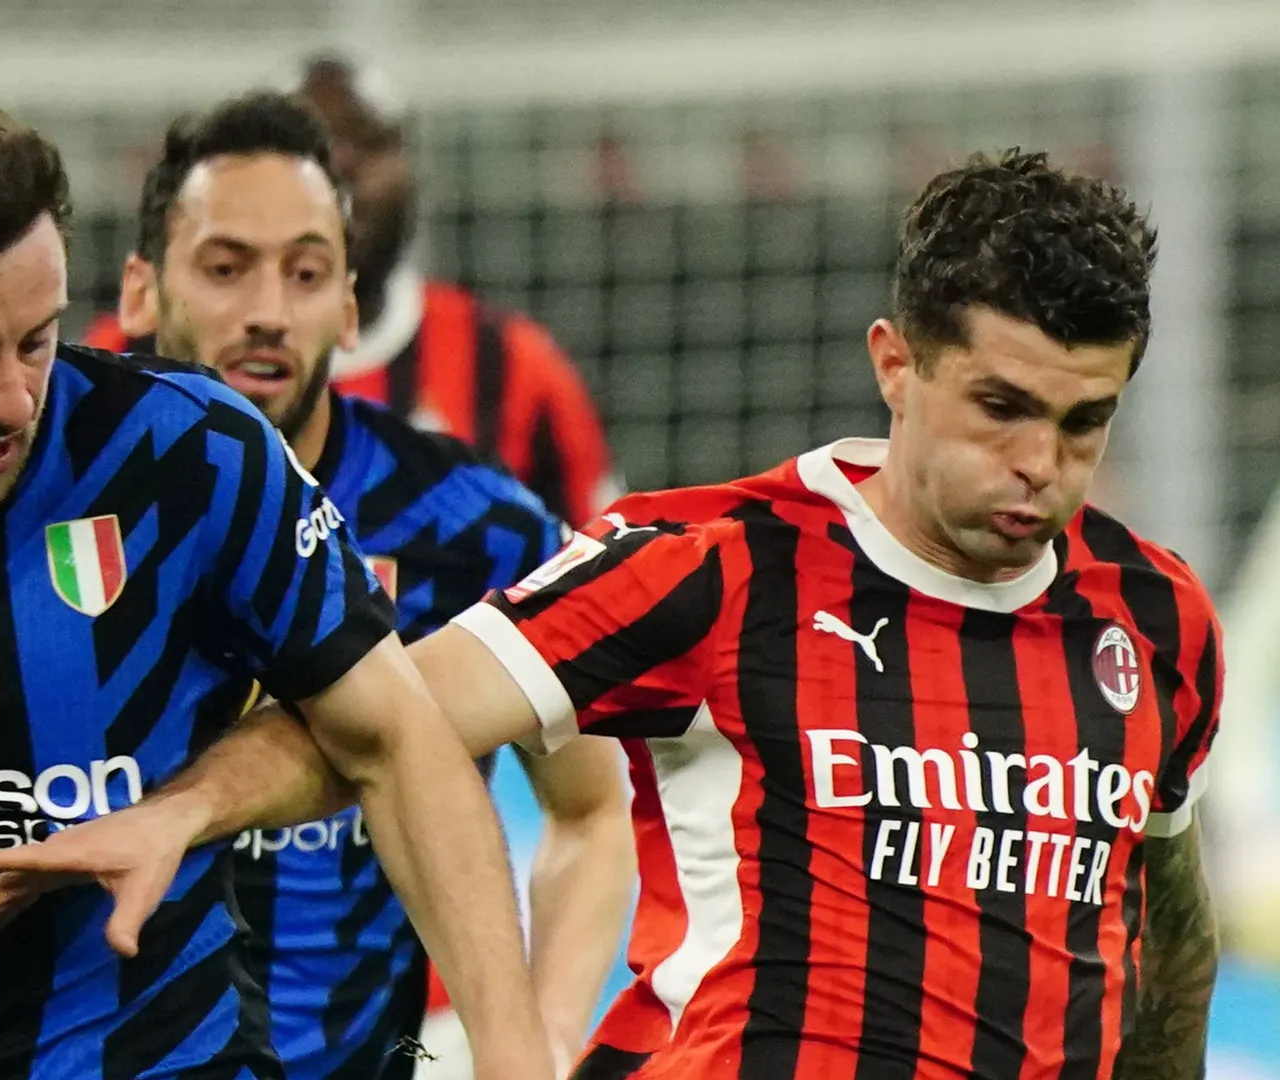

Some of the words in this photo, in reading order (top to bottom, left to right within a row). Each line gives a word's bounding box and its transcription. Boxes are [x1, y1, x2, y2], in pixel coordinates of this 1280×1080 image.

[805, 728, 1155, 834] Emirates
[869, 819, 956, 887] FLY
[966, 826, 1112, 906] BETTER
